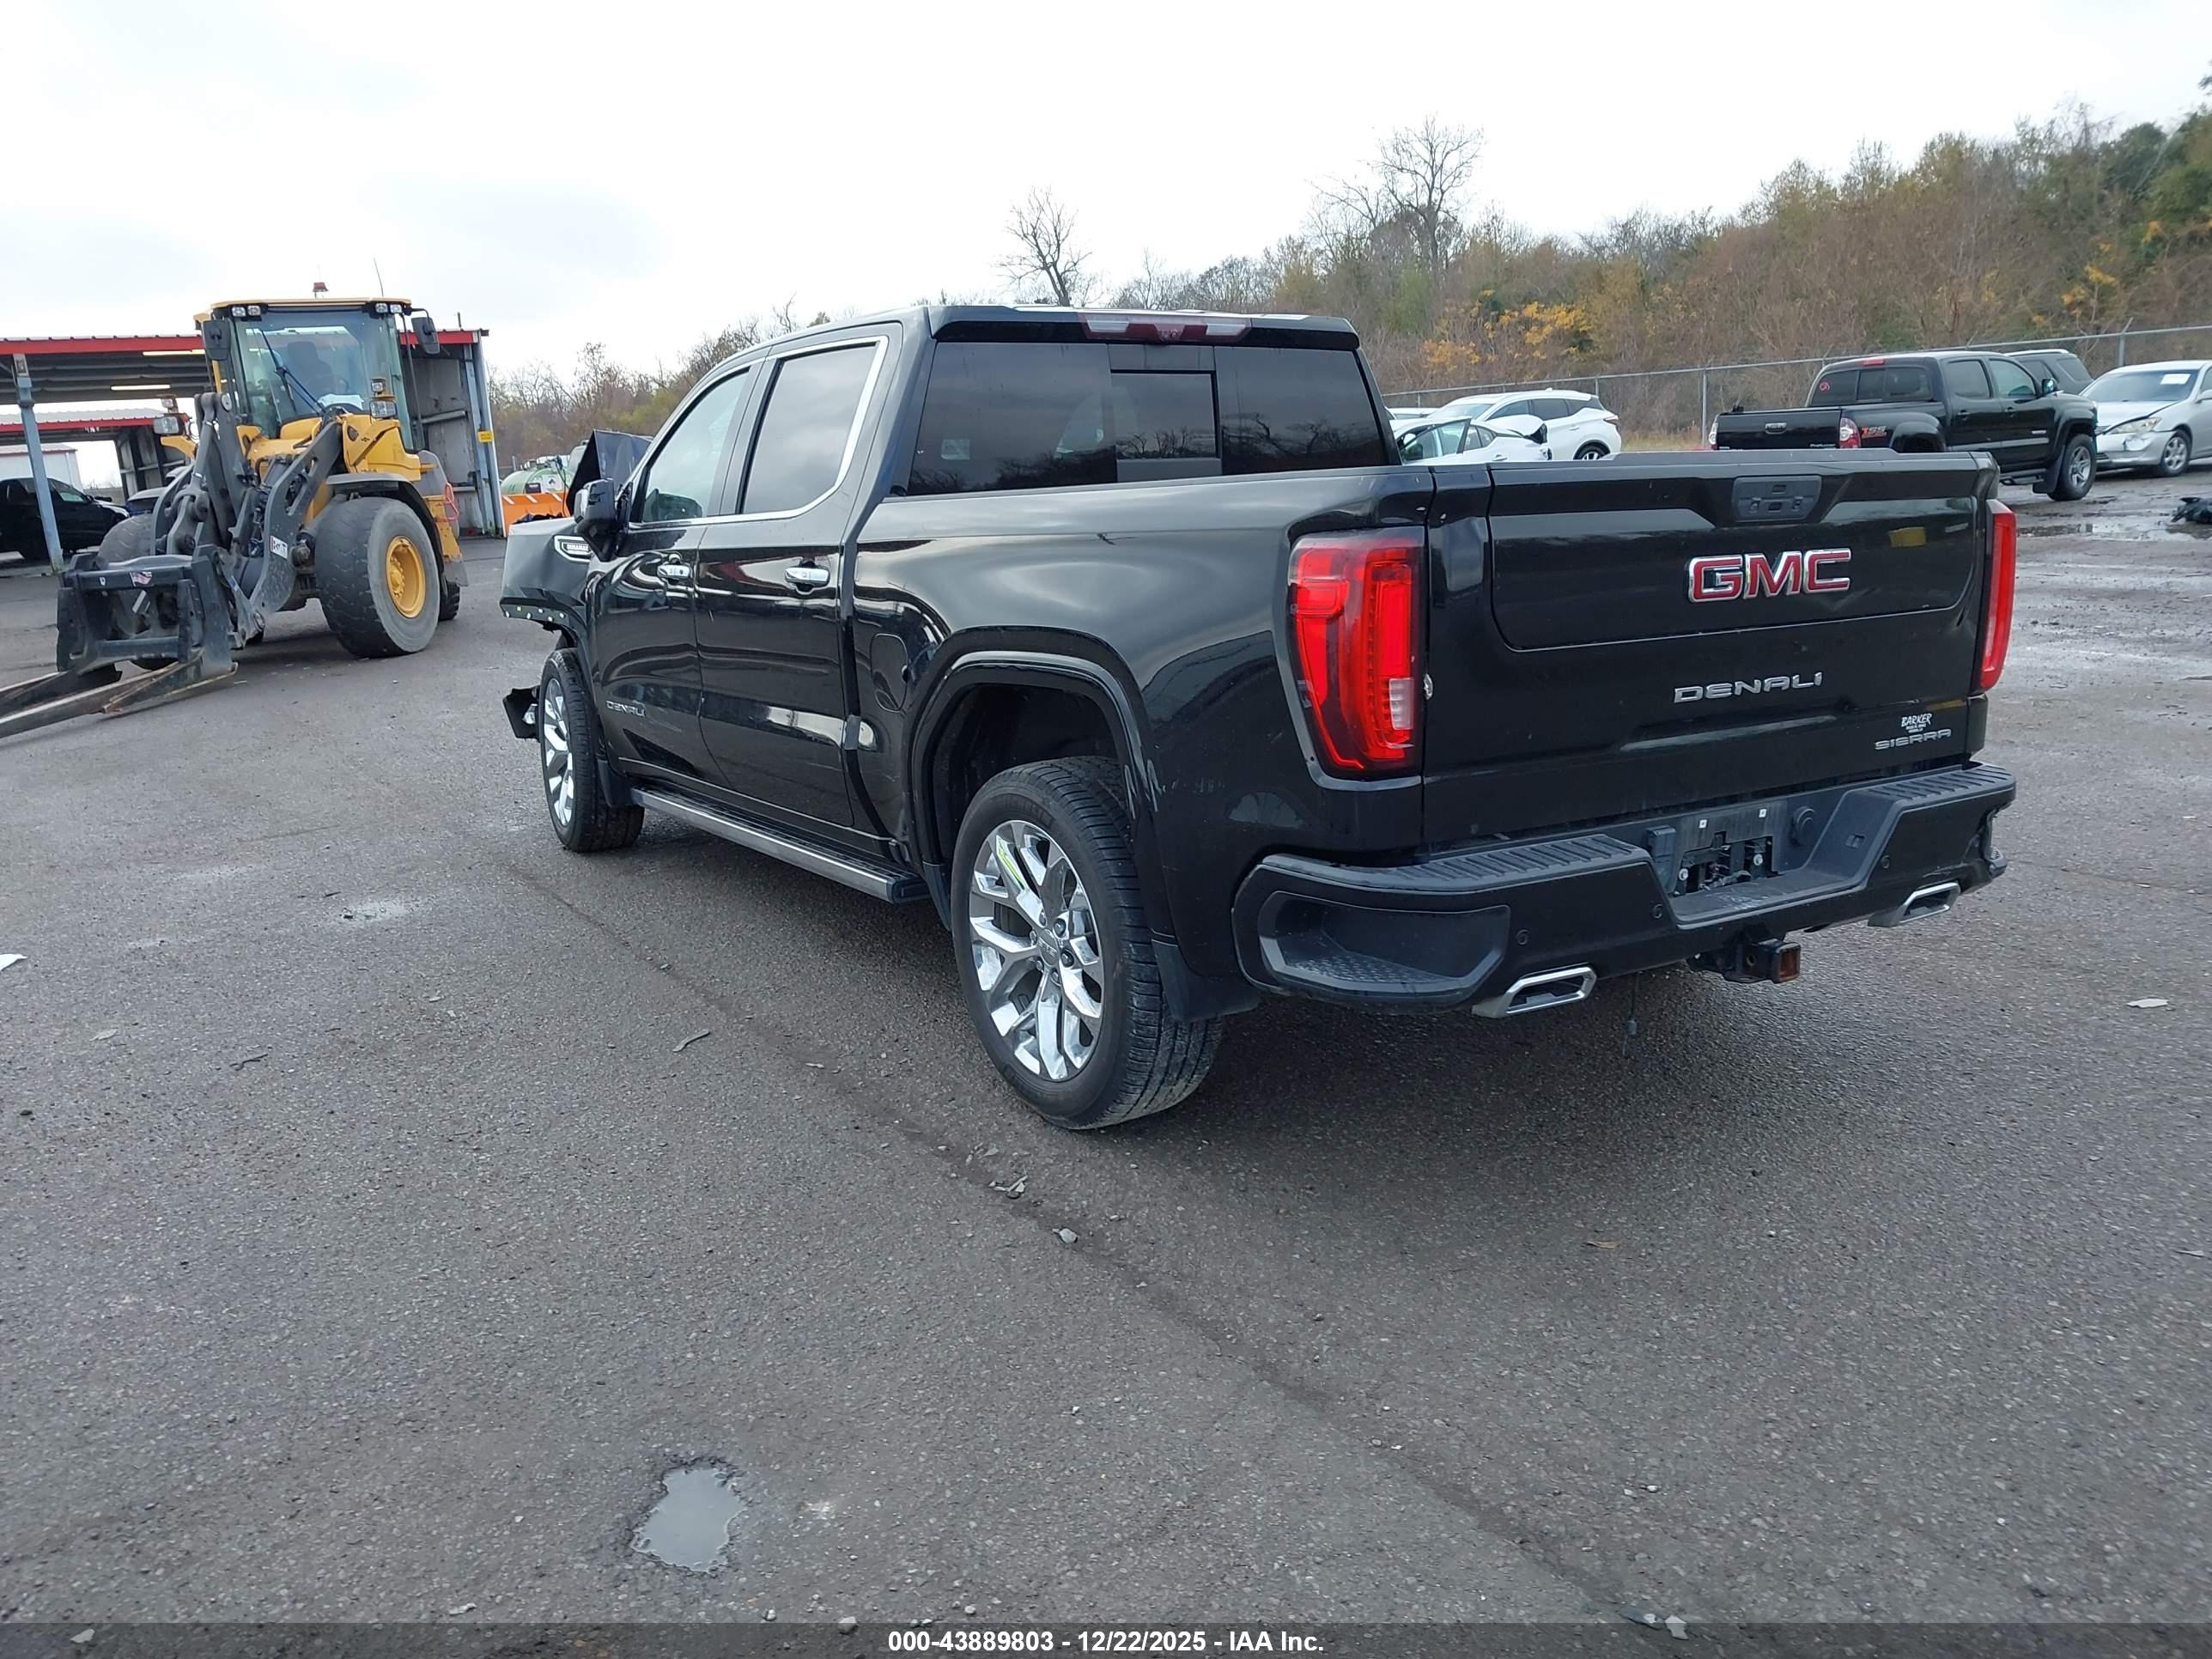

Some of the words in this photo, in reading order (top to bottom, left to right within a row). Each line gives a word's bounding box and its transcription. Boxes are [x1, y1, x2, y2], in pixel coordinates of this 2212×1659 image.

[1688, 547, 1851, 603] GMC
[1674, 672, 1822, 703] DENALI
[605, 700, 645, 717] DENALI
[1900, 713, 1932, 727] BARKER
[1875, 728, 1952, 750] SIERRA
